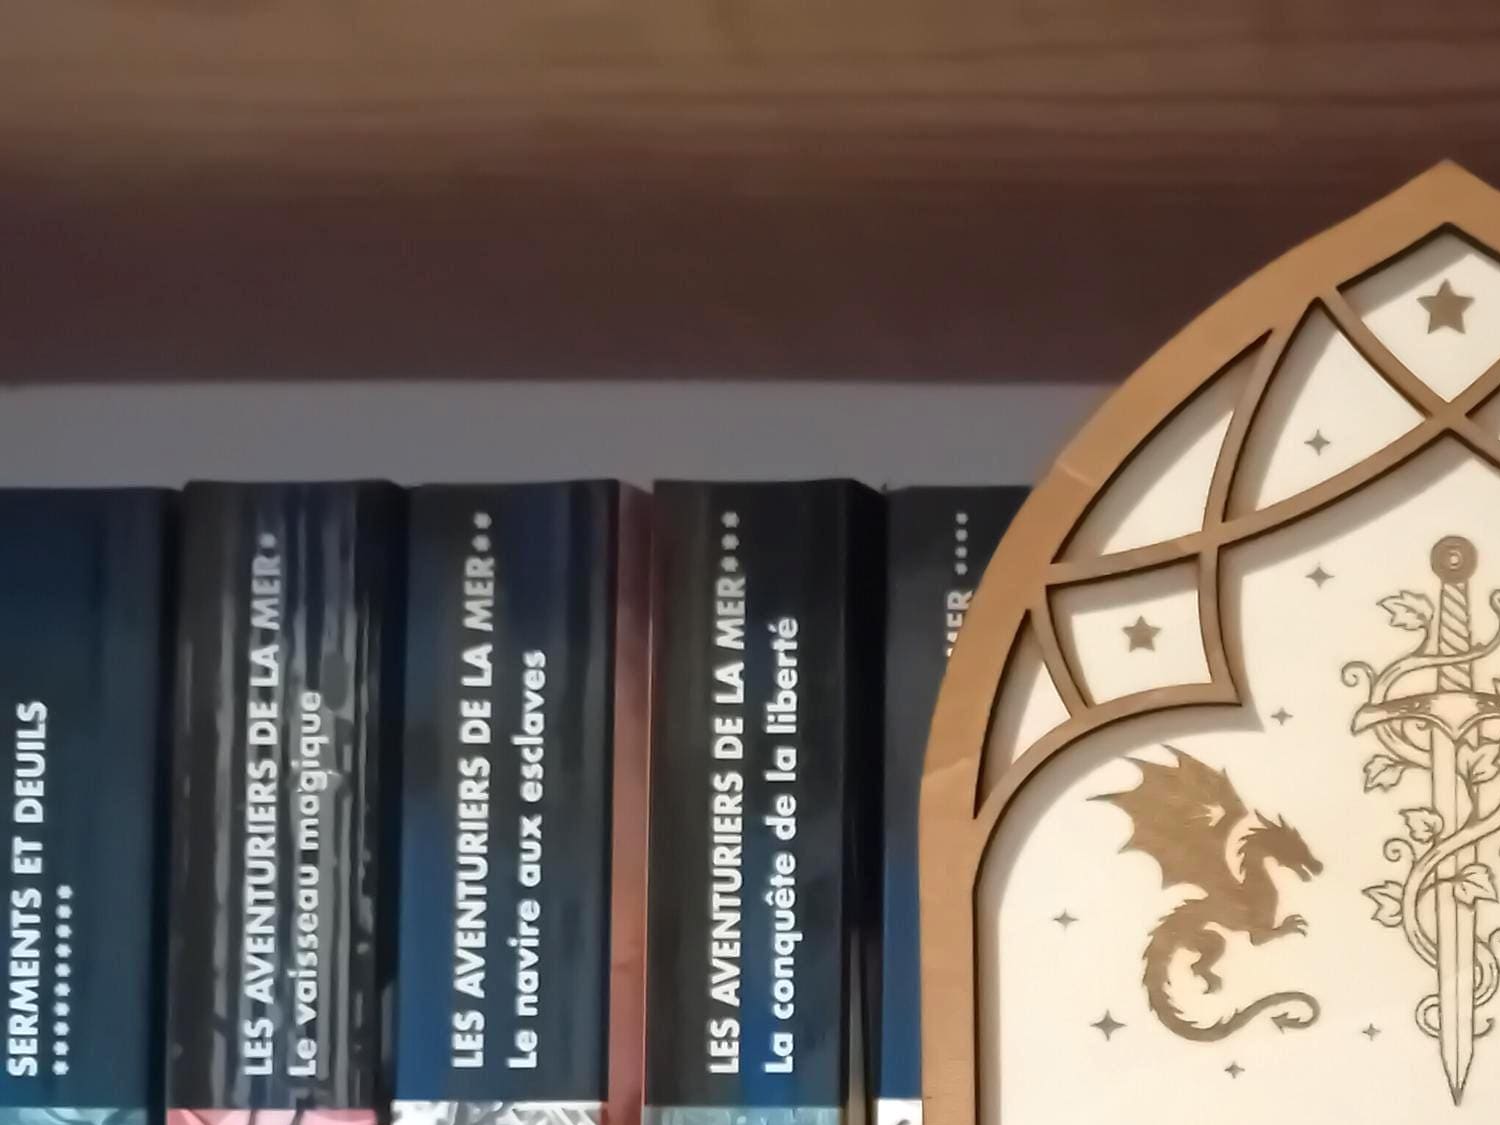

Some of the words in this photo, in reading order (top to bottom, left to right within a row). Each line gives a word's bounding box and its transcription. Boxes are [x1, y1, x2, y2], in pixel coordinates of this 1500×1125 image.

[250, 643, 280, 686] LA
[462, 643, 492, 686] LA
[714, 661, 745, 703] LA
[766, 616, 800, 733] liberté
[248, 701, 279, 744] DE
[459, 700, 490, 743] DE
[513, 649, 547, 801] esclaves
[713, 717, 744, 758] DE
[15, 699, 48, 822] DEUILS
[290, 690, 329, 849] magique
[766, 747, 799, 780] la
[766, 795, 797, 839] de
[13, 836, 43, 873] ET
[454, 757, 491, 997] AVENTURIERS
[514, 814, 543, 886] aux
[244, 759, 278, 1003] AVENTURIERS
[710, 771, 744, 1005] AVENTURIERS
[288, 864, 320, 1024] vaisseau
[508, 898, 541, 1015] navire
[765, 851, 804, 1018] conquête
[8, 887, 42, 1076] SERMENTS
[243, 1018, 275, 1075] LES
[288, 1037, 319, 1075] Le
[452, 1010, 485, 1067] LES
[507, 1029, 539, 1067] Le
[708, 1017, 740, 1073] LES
[764, 1032, 795, 1073] La
